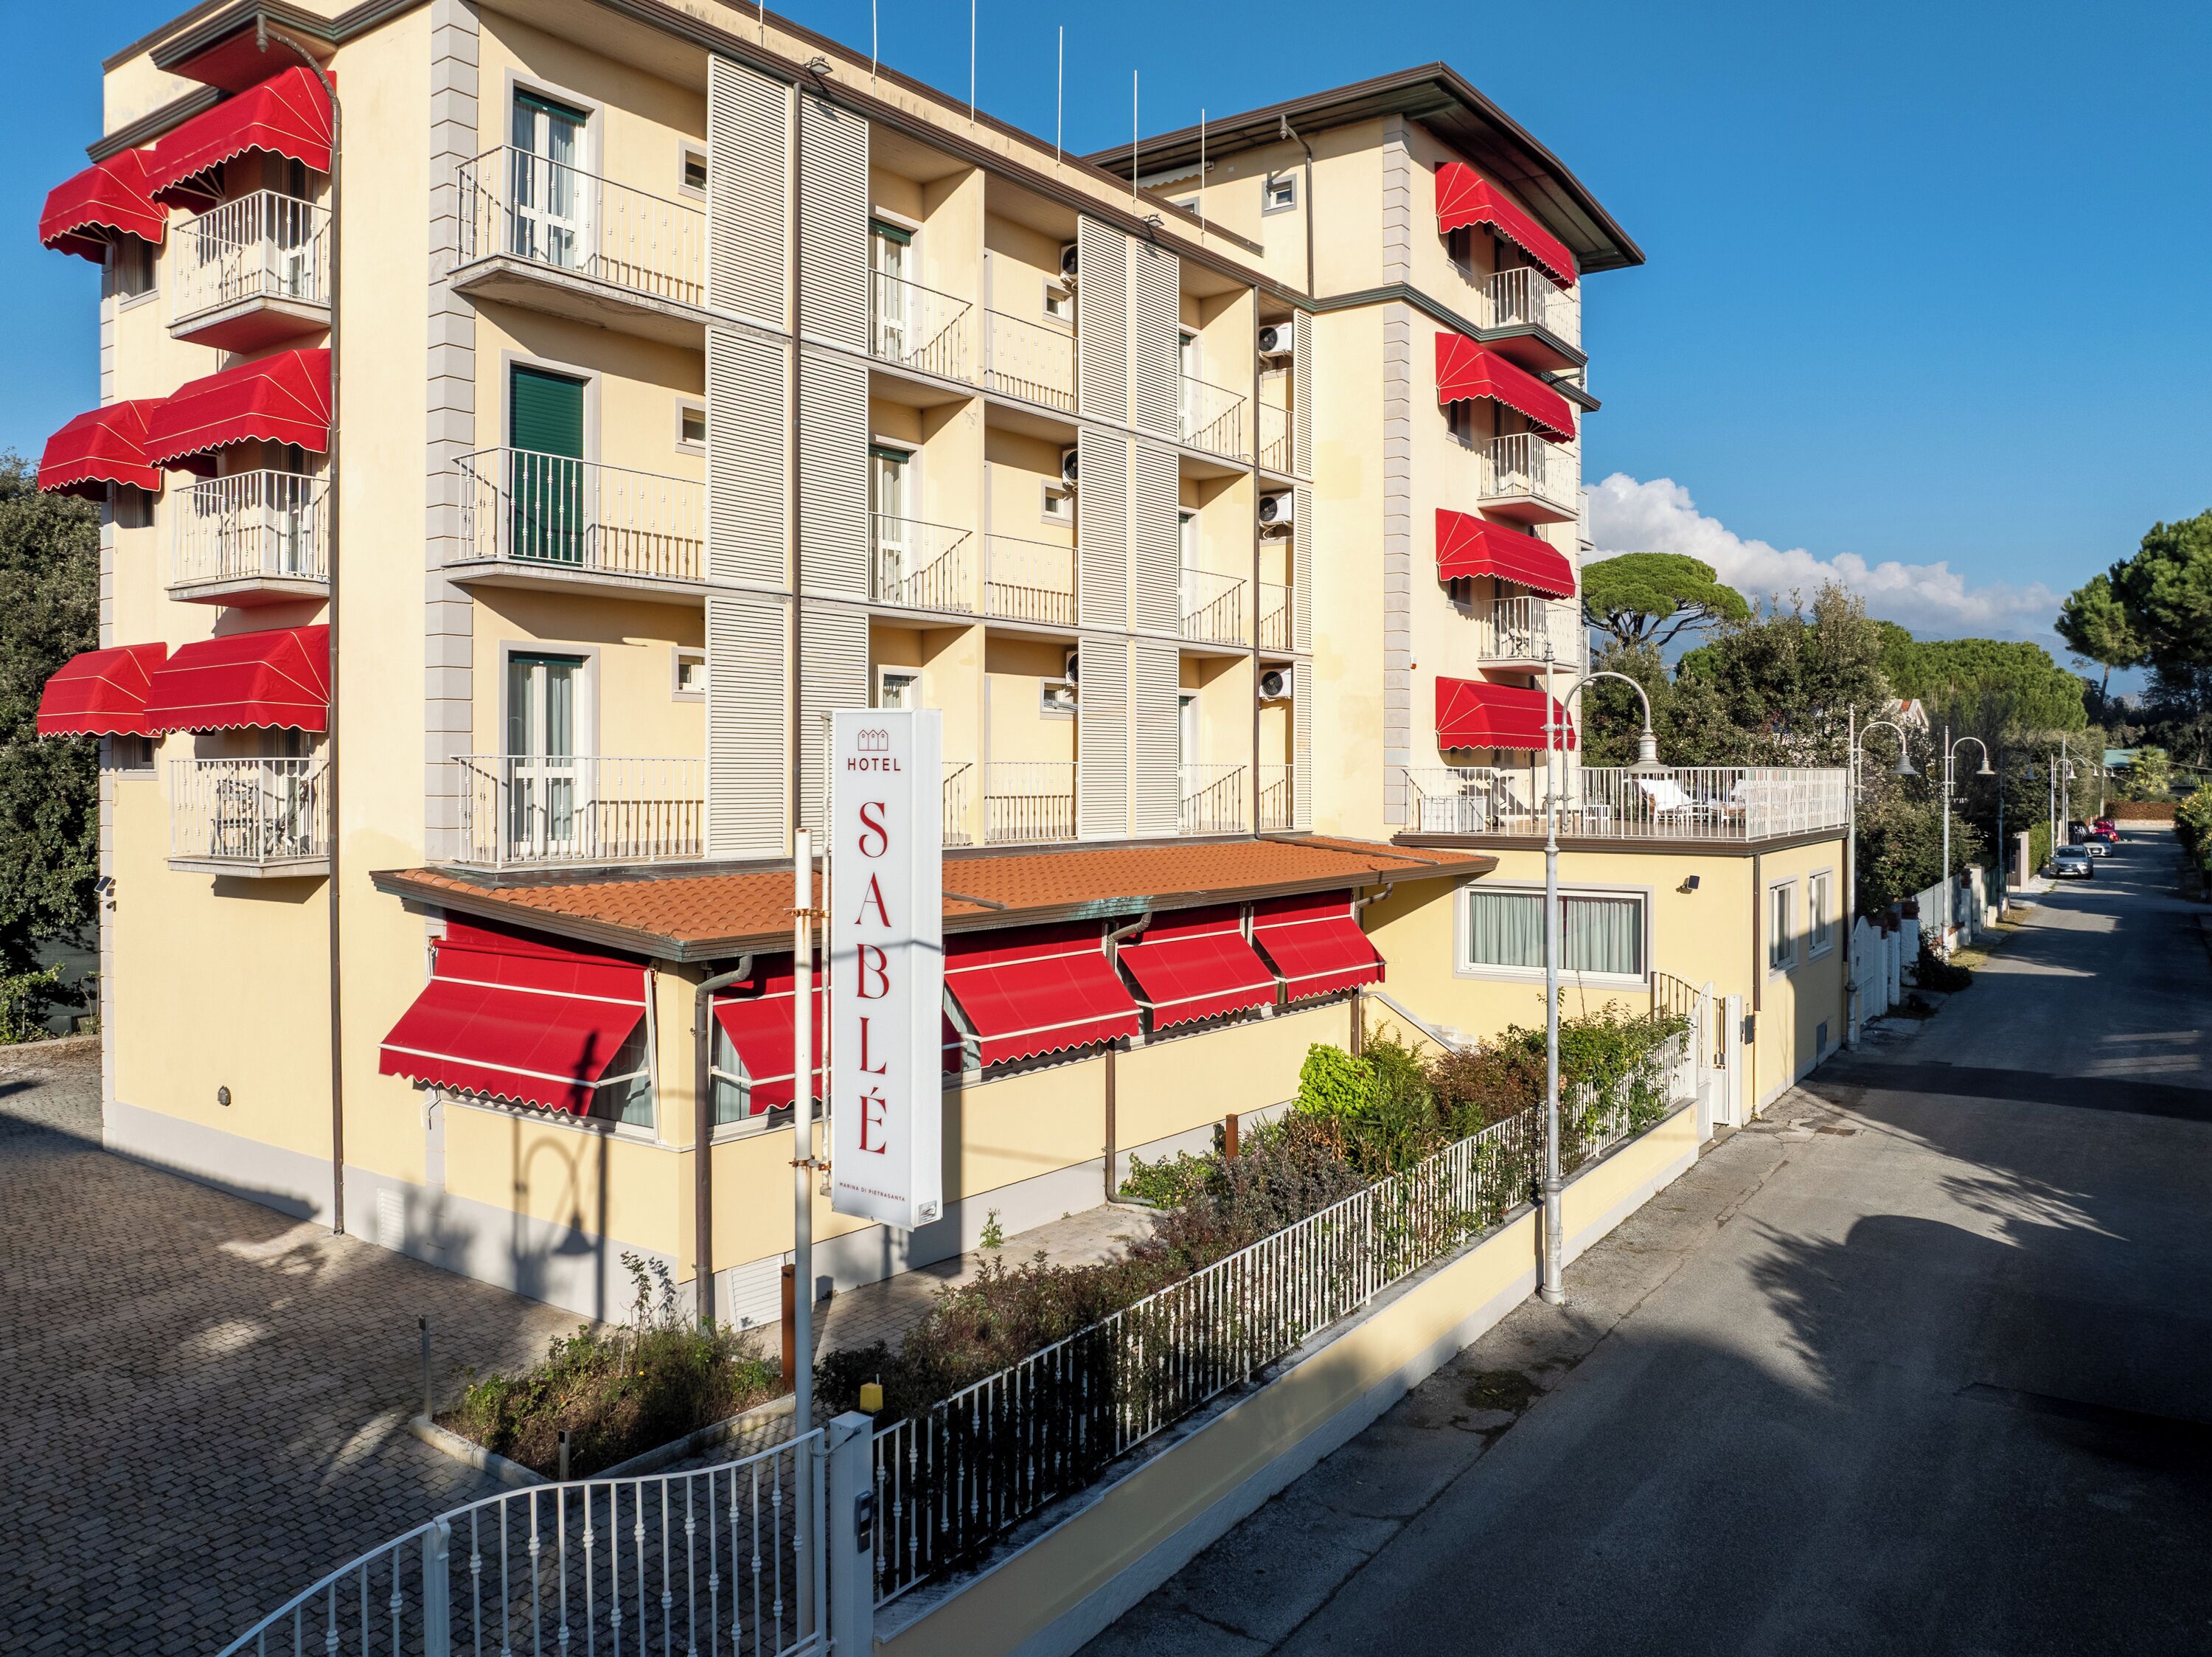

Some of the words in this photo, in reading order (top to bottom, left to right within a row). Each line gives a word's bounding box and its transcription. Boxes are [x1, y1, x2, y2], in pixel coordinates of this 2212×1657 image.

[847, 757, 901, 771] HOTEL
[854, 801, 892, 1155] SABLÉ
[839, 1182, 859, 1191] MARINA
[869, 1189, 905, 1202] PIETRASANTA
